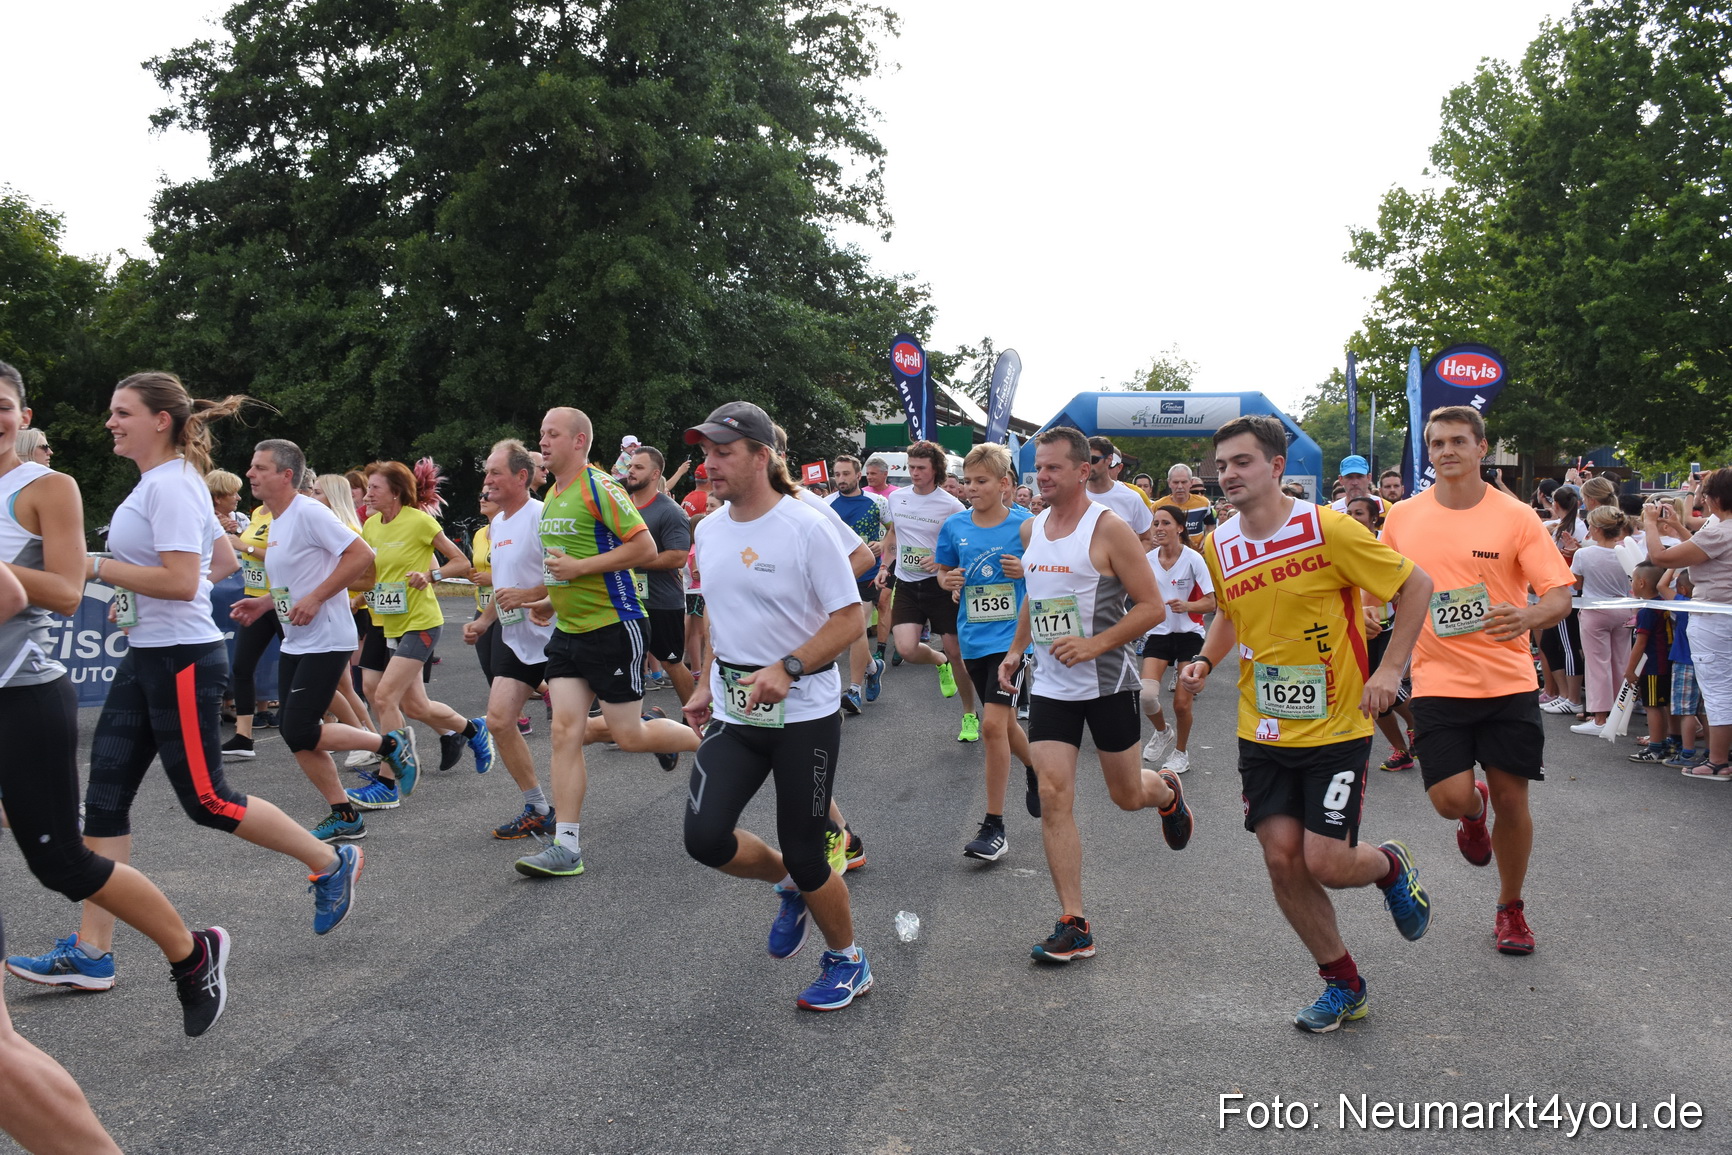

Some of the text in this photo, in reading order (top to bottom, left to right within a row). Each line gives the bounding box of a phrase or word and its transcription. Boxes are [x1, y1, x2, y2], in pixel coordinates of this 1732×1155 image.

[1443, 359, 1497, 381] Hervis
[1151, 414, 1205, 425] firmenlauf
[903, 554, 927, 565] 209
[1471, 550, 1500, 560] THULE
[1038, 564, 1074, 574] KLEBL
[1225, 573, 1268, 602] MAX
[1271, 553, 1331, 583] BÖGL
[376, 593, 401, 606] 1244
[972, 596, 1010, 613] 1536
[1436, 601, 1485, 625] 2283
[1034, 613, 1072, 633] 1171
[1262, 682, 1316, 704] 1629
[812, 748, 829, 817] 2XU
[1322, 770, 1356, 811] 6
[1325, 818, 1343, 826] umbro
